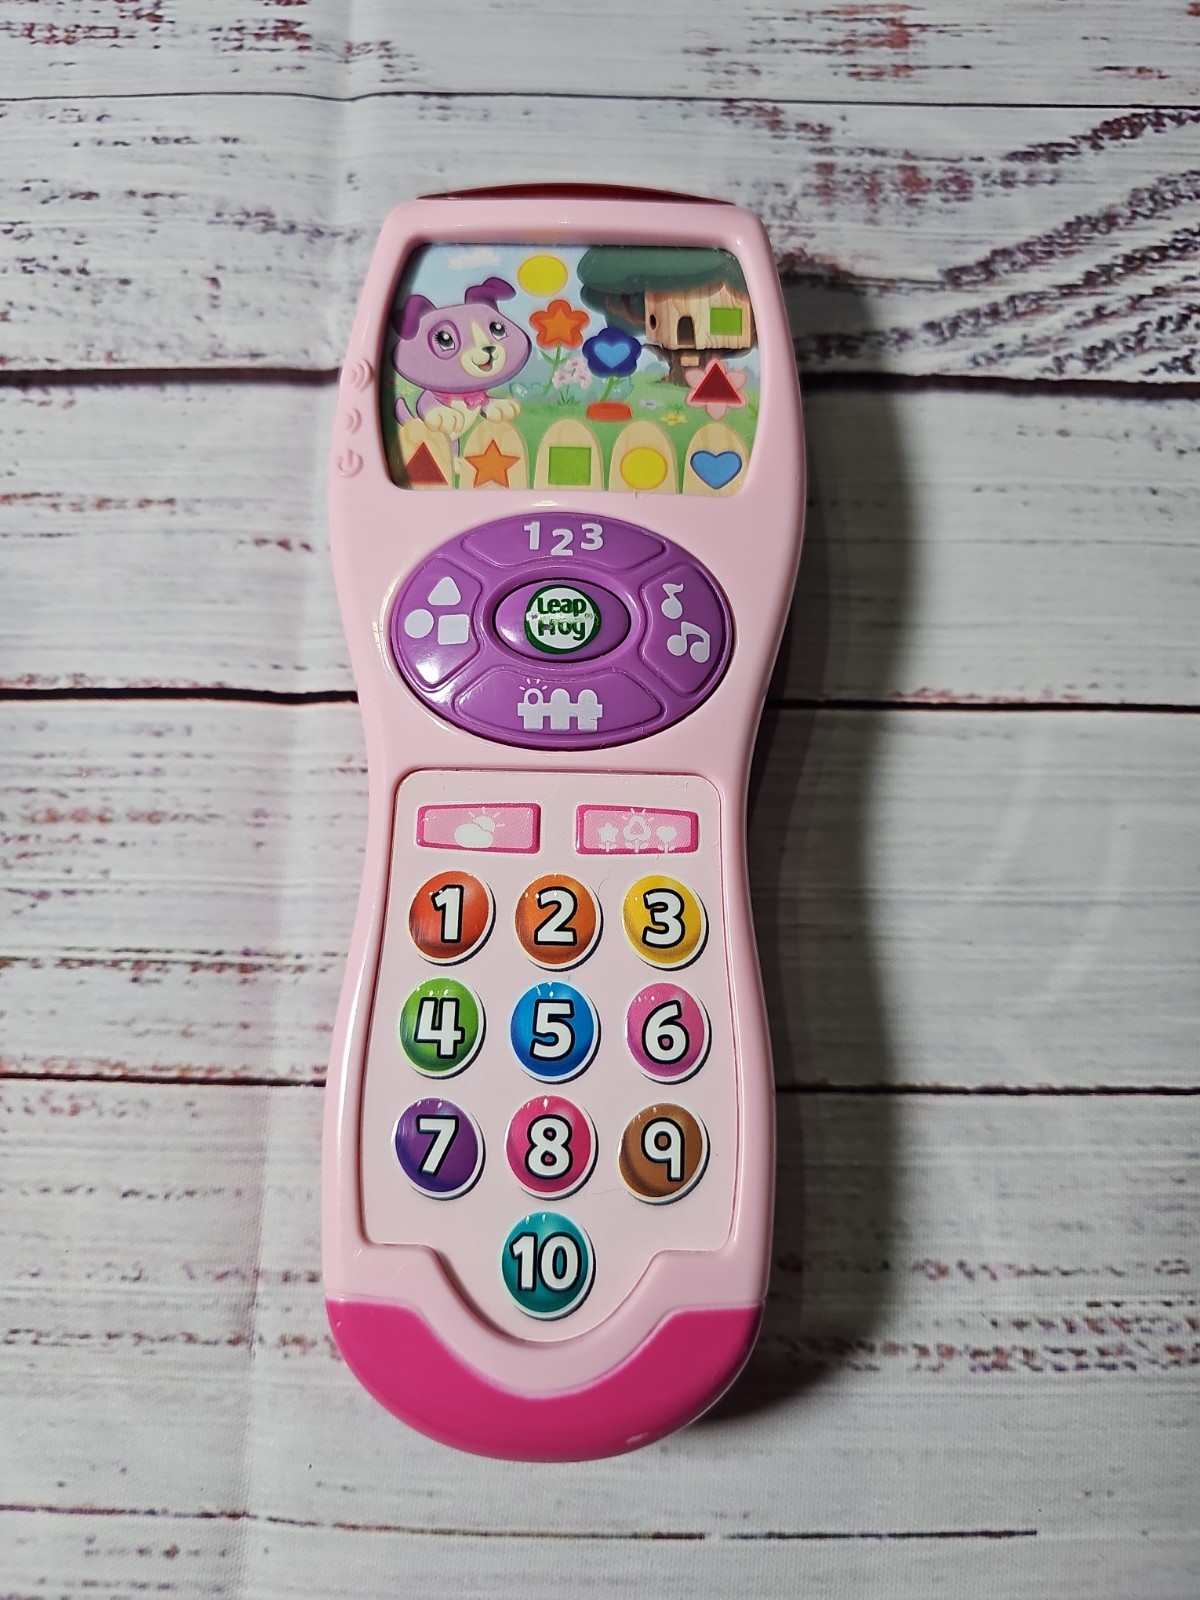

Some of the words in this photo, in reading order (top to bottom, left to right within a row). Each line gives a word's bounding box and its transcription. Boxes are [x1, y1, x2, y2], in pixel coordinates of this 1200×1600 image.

[537, 597, 587, 617] Leap
[431, 884, 464, 943] 1
[534, 886, 578, 946] 2
[642, 888, 685, 949] 3
[414, 997, 465, 1059] 4
[529, 998, 575, 1061] 5
[642, 1000, 690, 1065] 6
[416, 1115, 459, 1177] 7
[525, 1114, 573, 1180] 8
[641, 1117, 685, 1181] 9
[509, 1231, 582, 1291] 10
